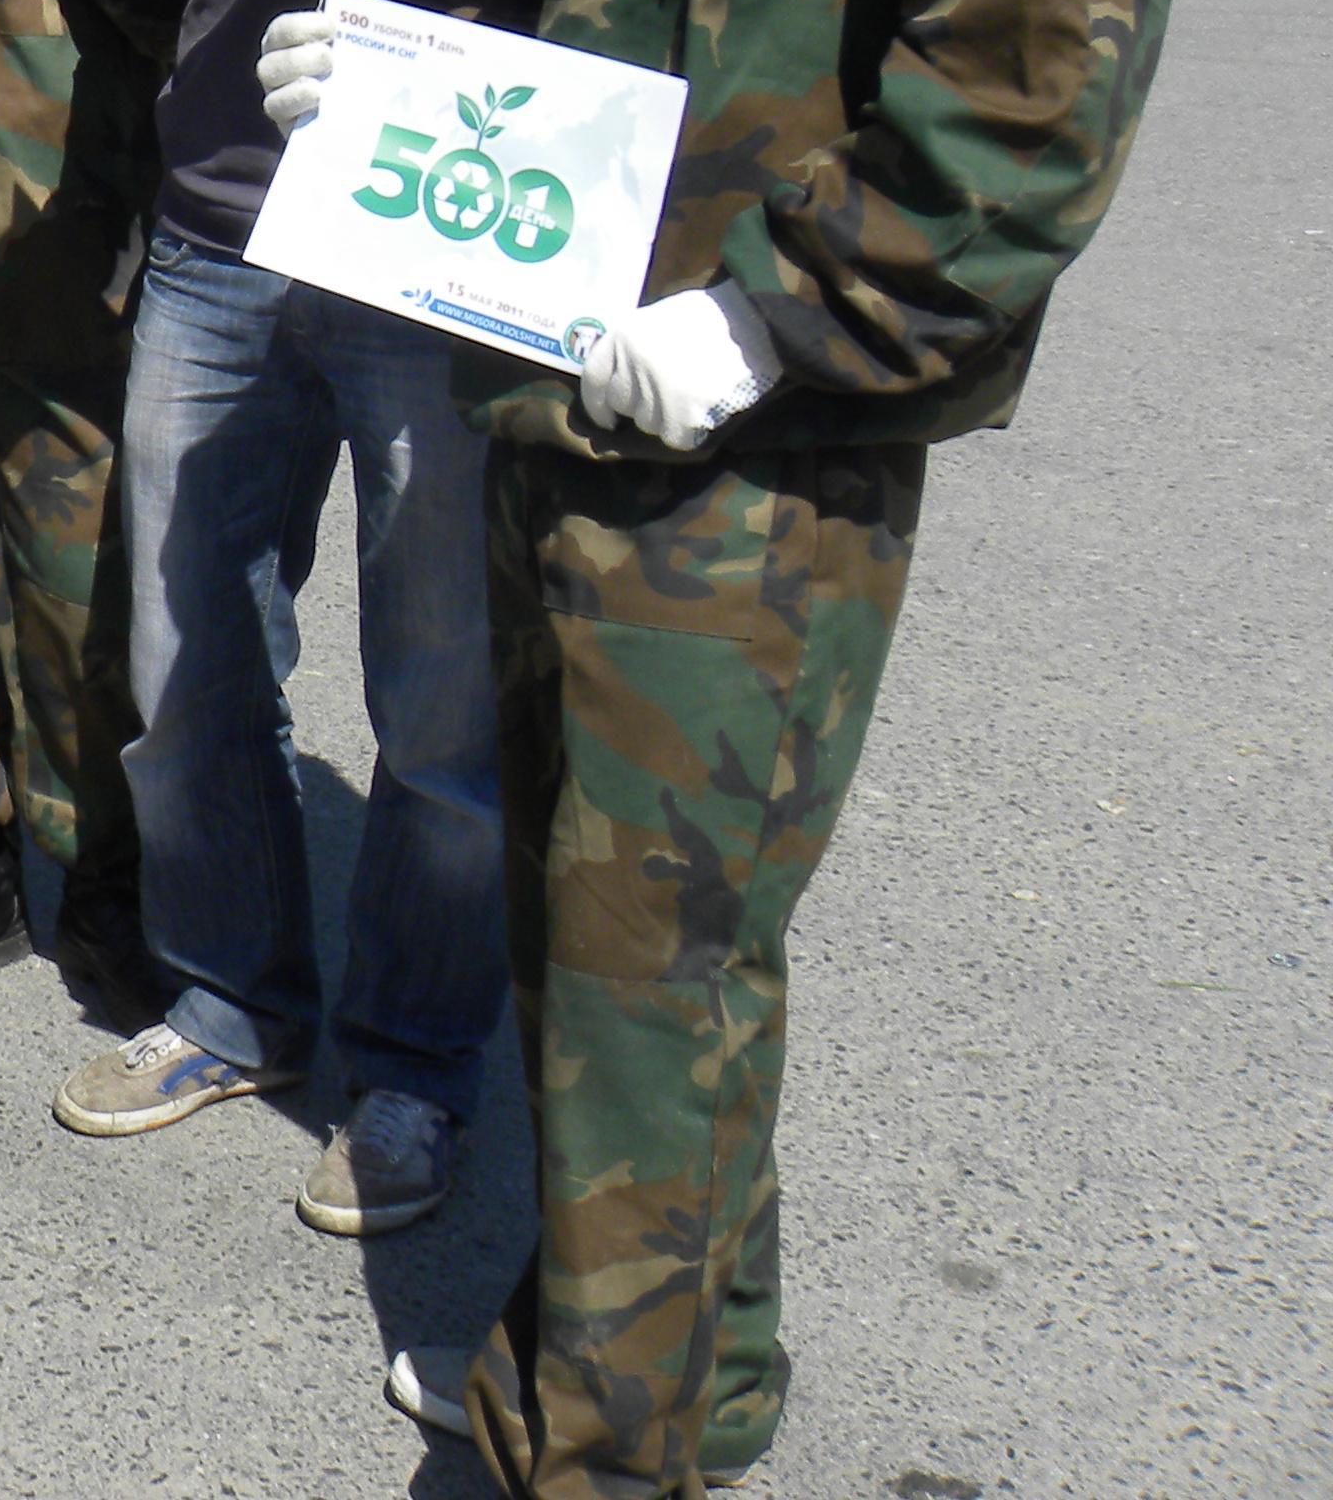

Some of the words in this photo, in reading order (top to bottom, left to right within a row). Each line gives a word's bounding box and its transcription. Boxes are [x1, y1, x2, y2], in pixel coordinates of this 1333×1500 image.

[339, 10, 370, 29] 500
[372, 22, 414, 42] УБОРОК
[427, 34, 436, 48] 1
[437, 40, 466, 56] ДЕНЬ
[345, 32, 386, 51] РОССИИ
[398, 47, 419, 60] СНГ
[447, 281, 465, 297] 15
[496, 300, 524, 318] 2011
[436, 301, 557, 350] WWW.MUSORA.BOLSHE.NET
